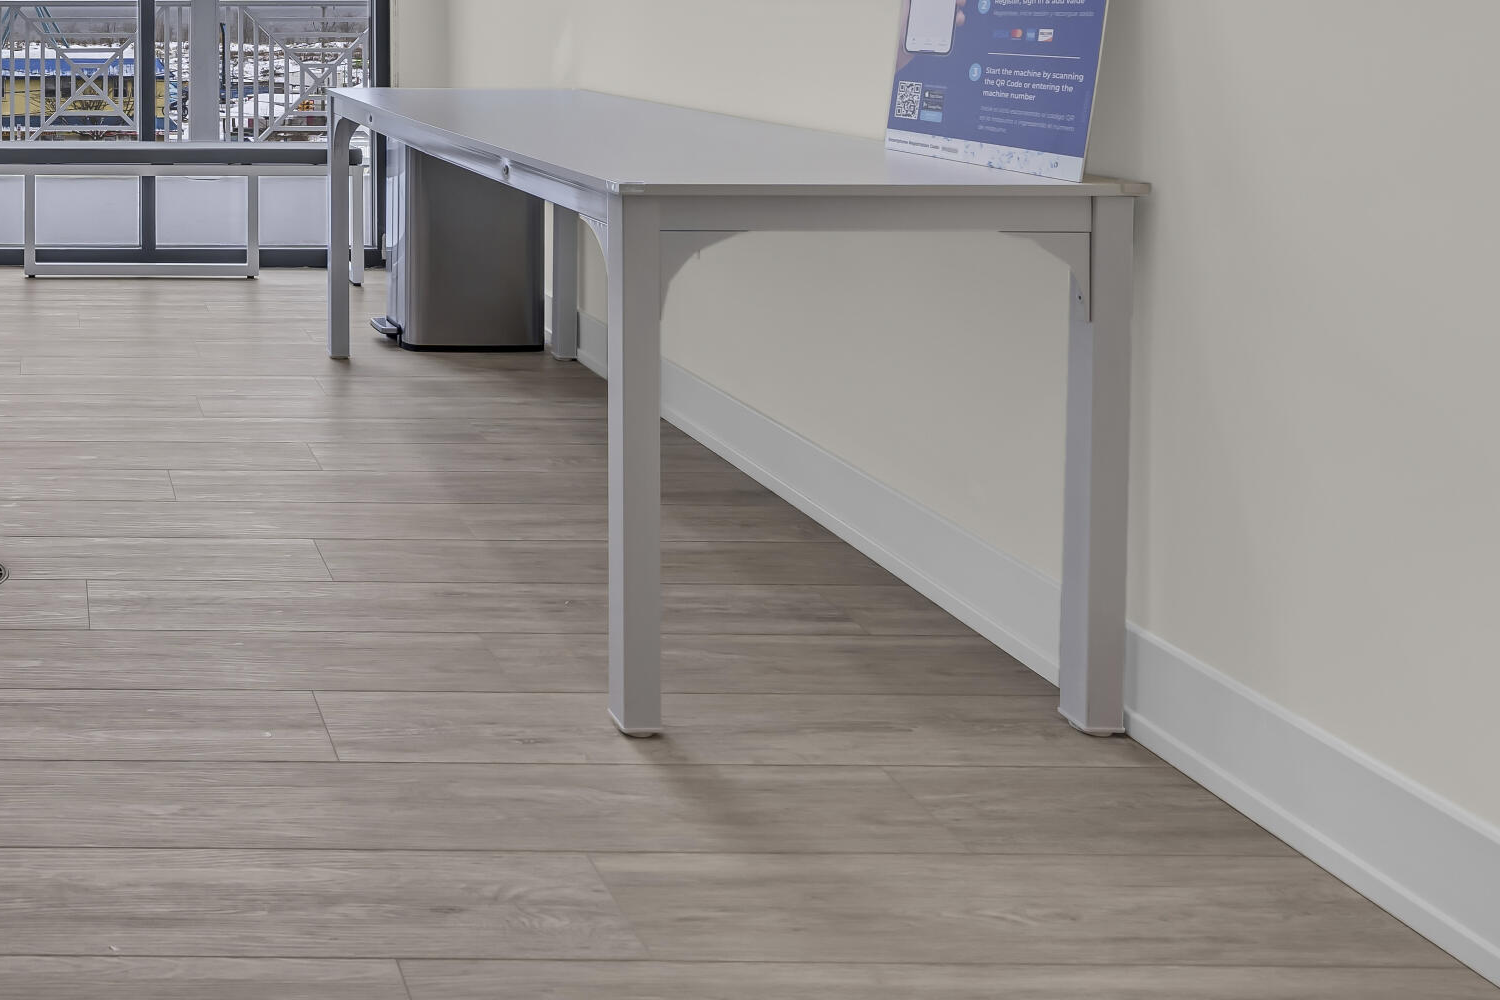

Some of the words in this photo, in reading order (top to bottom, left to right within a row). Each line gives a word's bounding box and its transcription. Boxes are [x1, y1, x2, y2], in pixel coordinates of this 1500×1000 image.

[985, 67, 1001, 75] Start
[1013, 69, 1041, 78] machine
[1042, 71, 1051, 79] by
[1052, 71, 1084, 82] scanning
[984, 78, 995, 86] the
[995, 79, 1005, 87] QR
[1006, 80, 1023, 88] Code
[1032, 82, 1061, 92] entering
[1061, 84, 1074, 92] the
[982, 89, 1009, 98] machine
[1010, 91, 1036, 101] number
